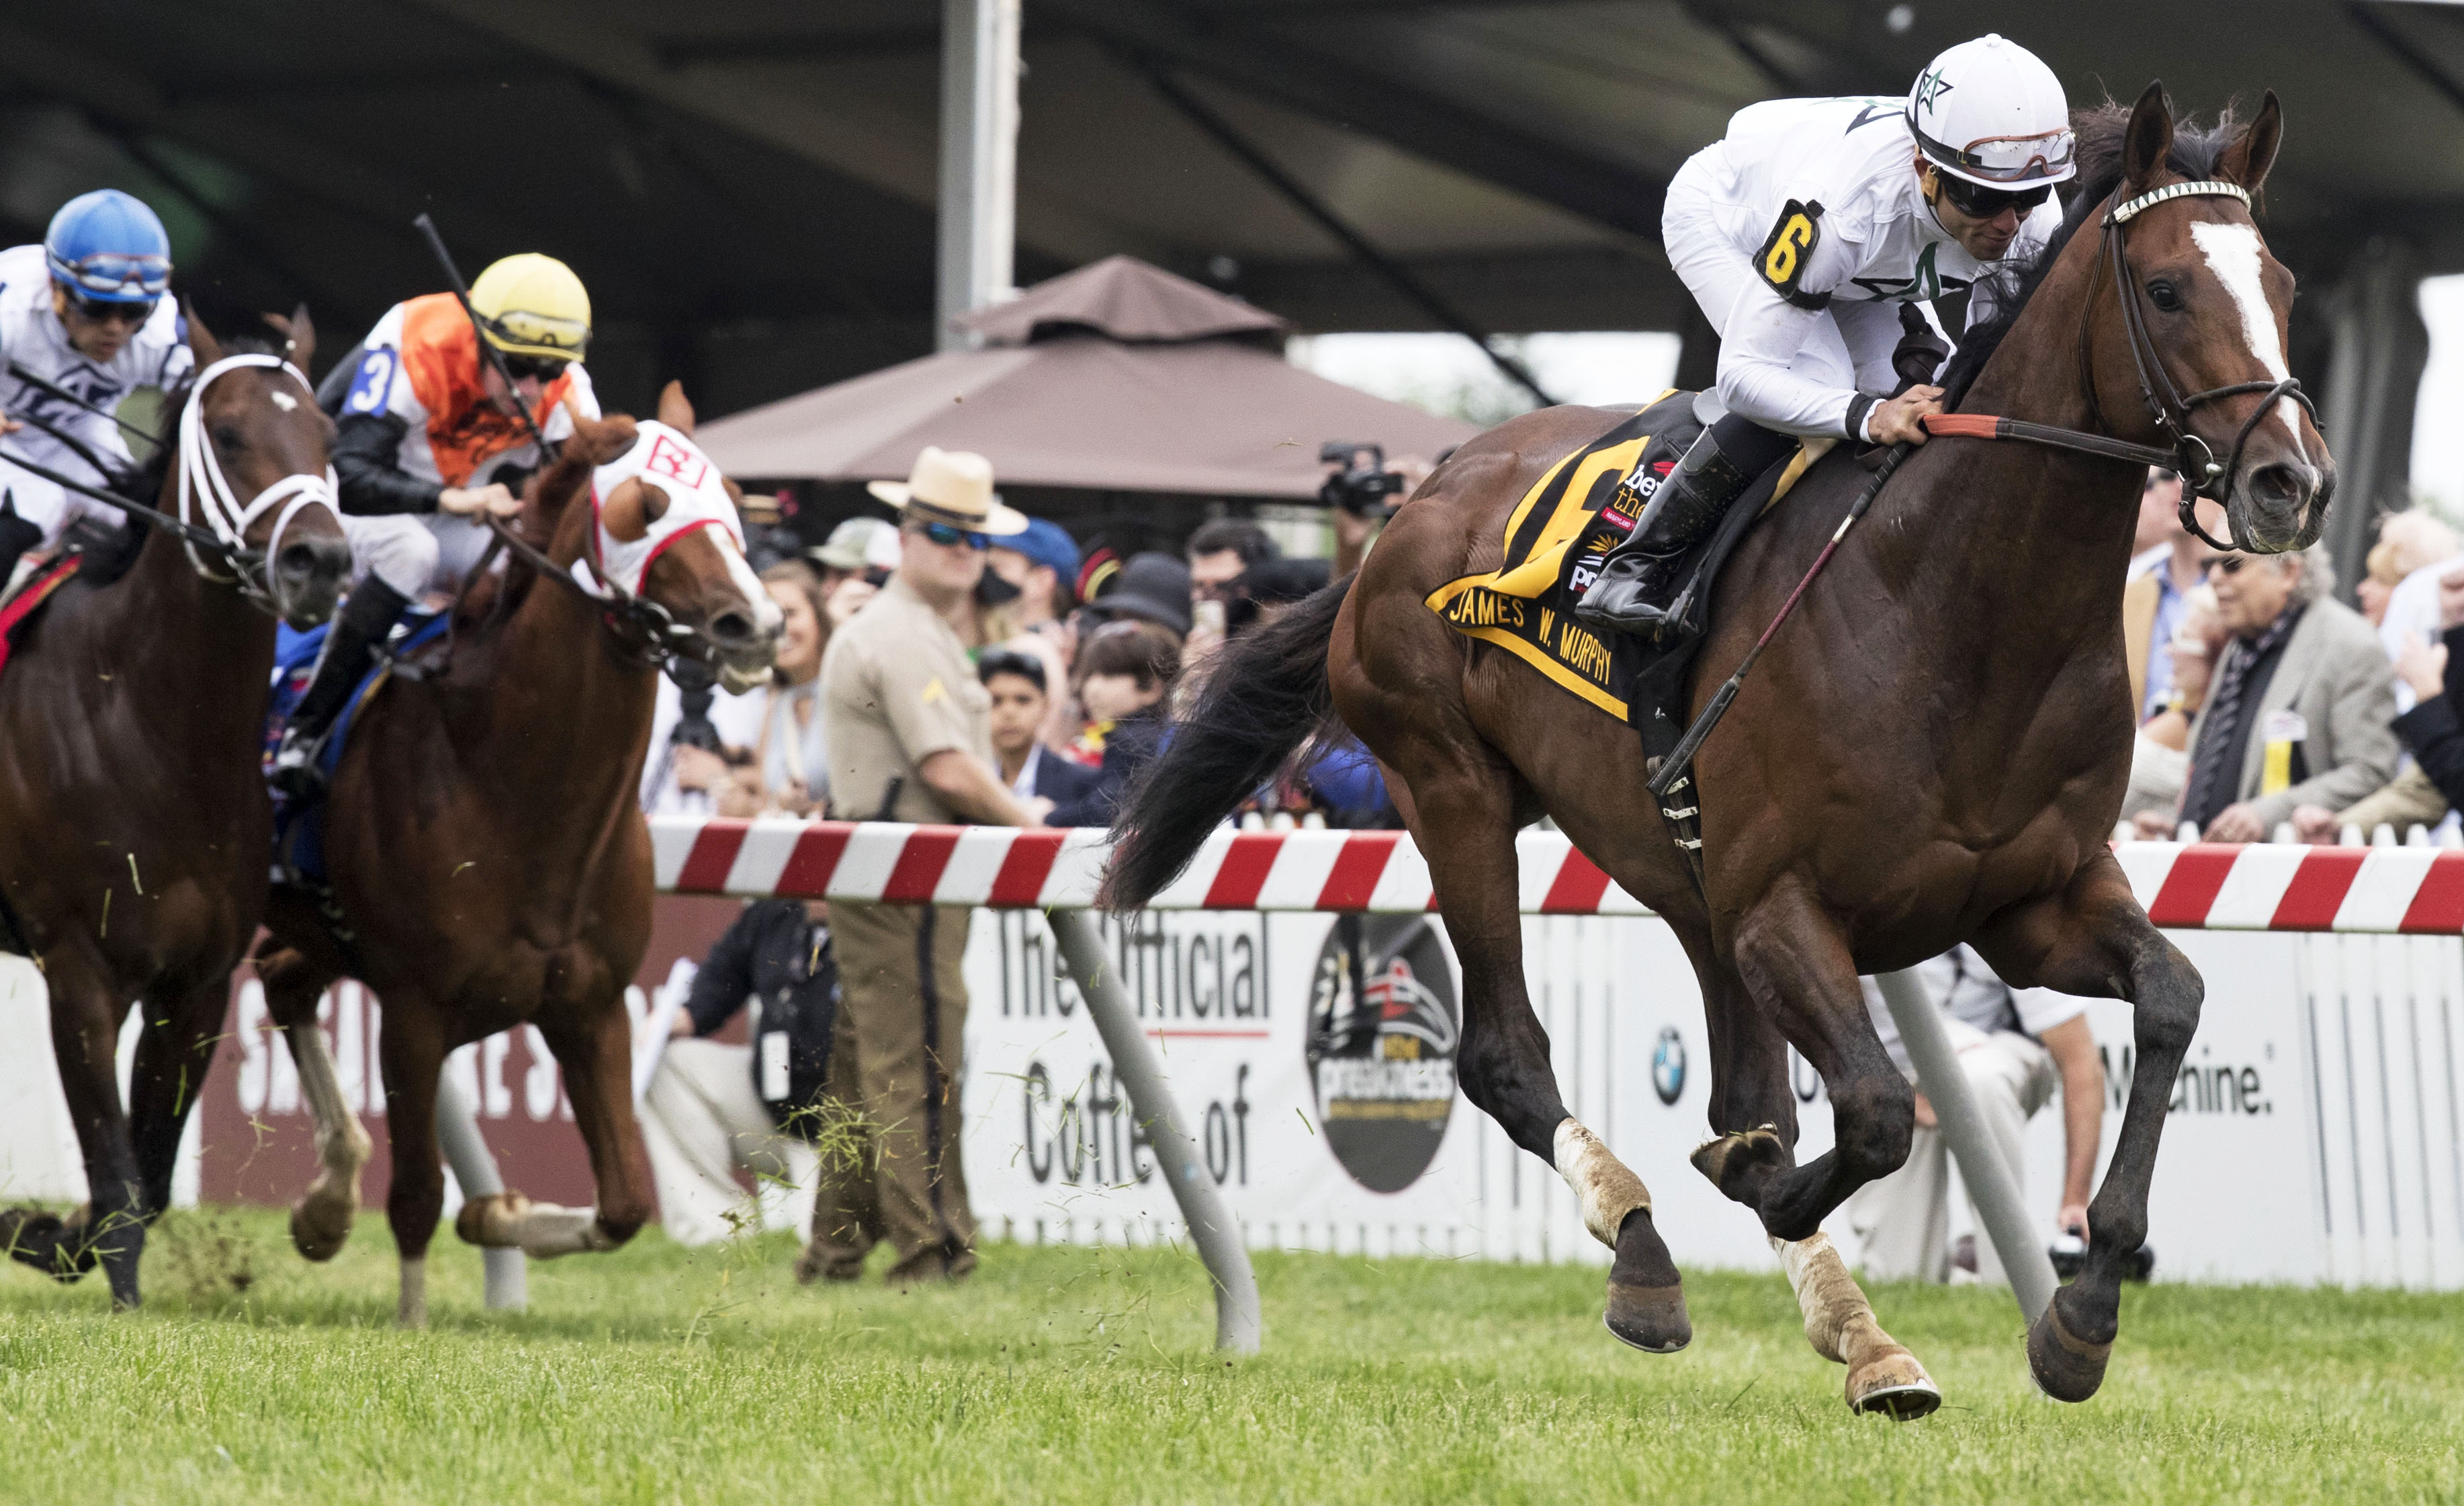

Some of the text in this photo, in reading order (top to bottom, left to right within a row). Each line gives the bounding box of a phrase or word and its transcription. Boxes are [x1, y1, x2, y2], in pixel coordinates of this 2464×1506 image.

[1765, 213, 1812, 283] 6
[352, 352, 391, 412] 3
[1450, 588, 1612, 685] JAMES W. MURPHY
[1000, 910, 1077, 1018] The
[1205, 1063, 1249, 1186] of
